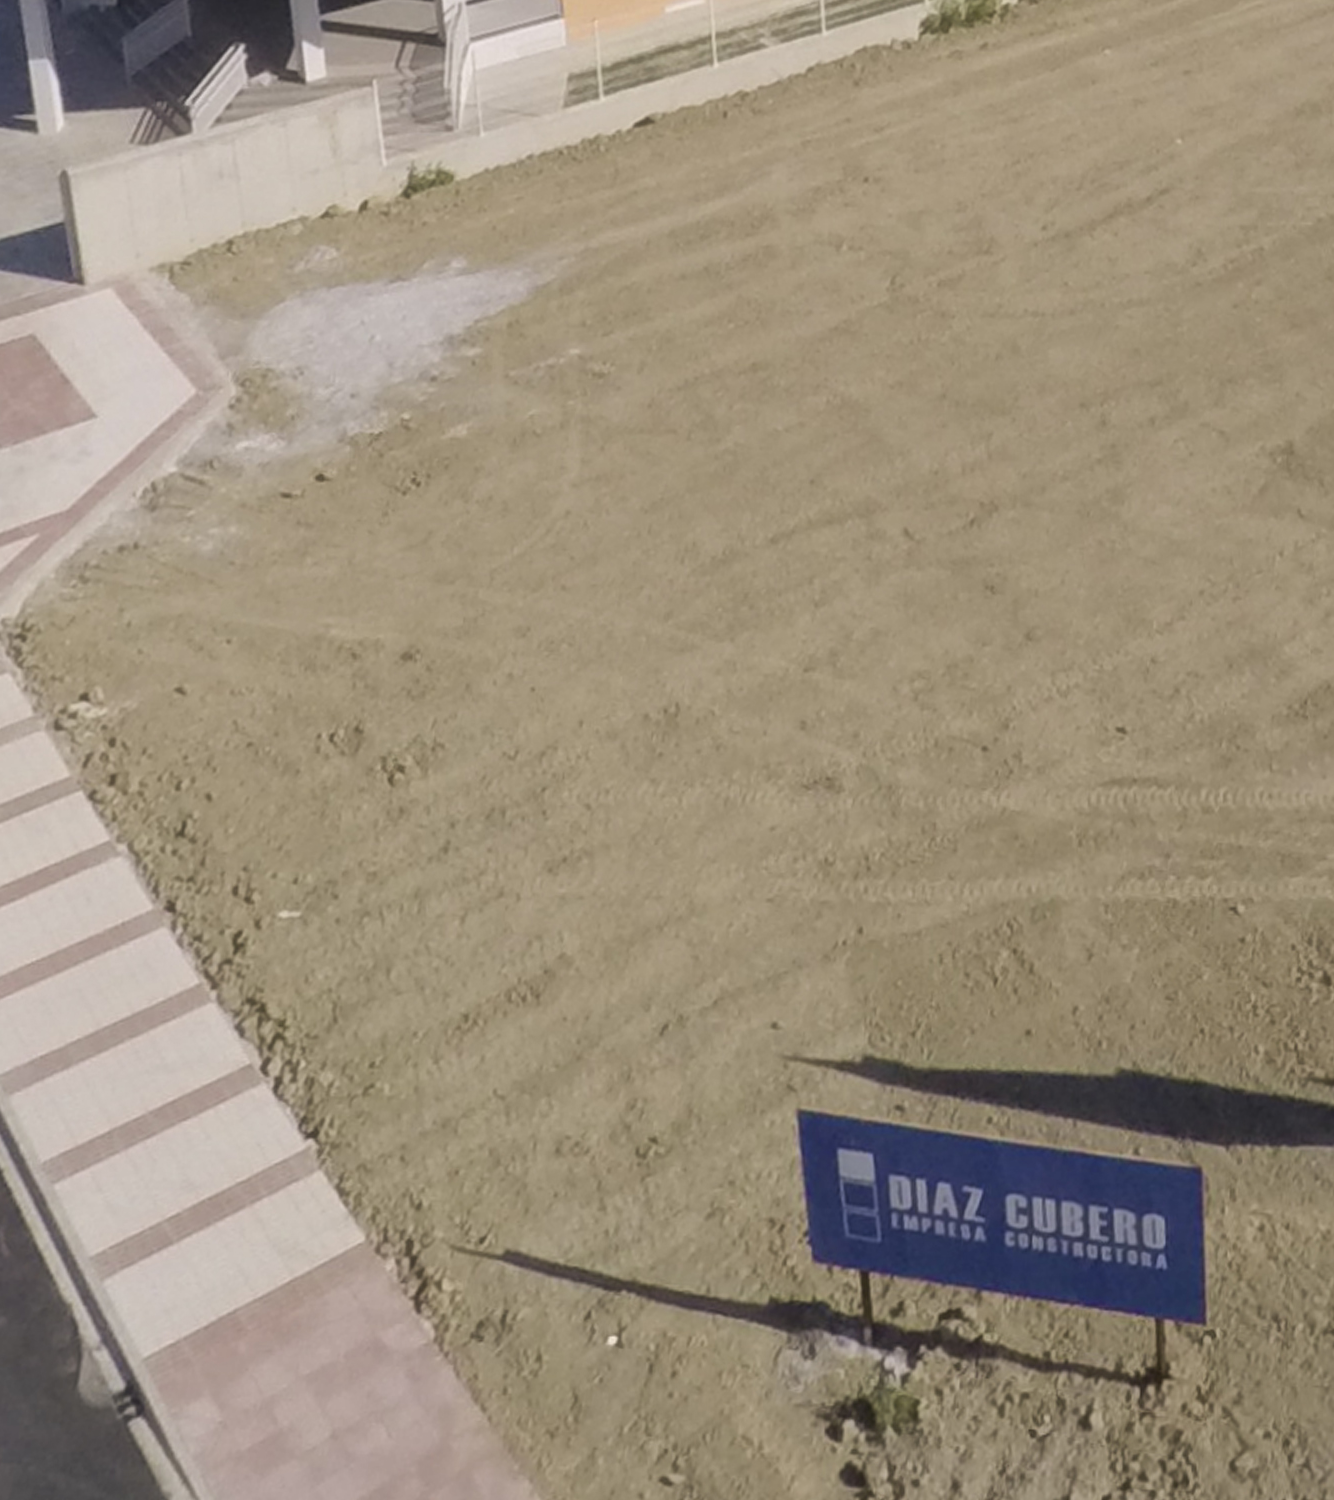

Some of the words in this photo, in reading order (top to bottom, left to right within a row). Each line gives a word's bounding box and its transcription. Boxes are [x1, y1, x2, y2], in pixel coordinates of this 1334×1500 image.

[888, 1173, 986, 1223] DIAZ
[1005, 1193, 1167, 1249] CUBERO
[890, 1211, 987, 1243] EMPRESA
[1004, 1230, 1168, 1270] CONSTRUCTORA
